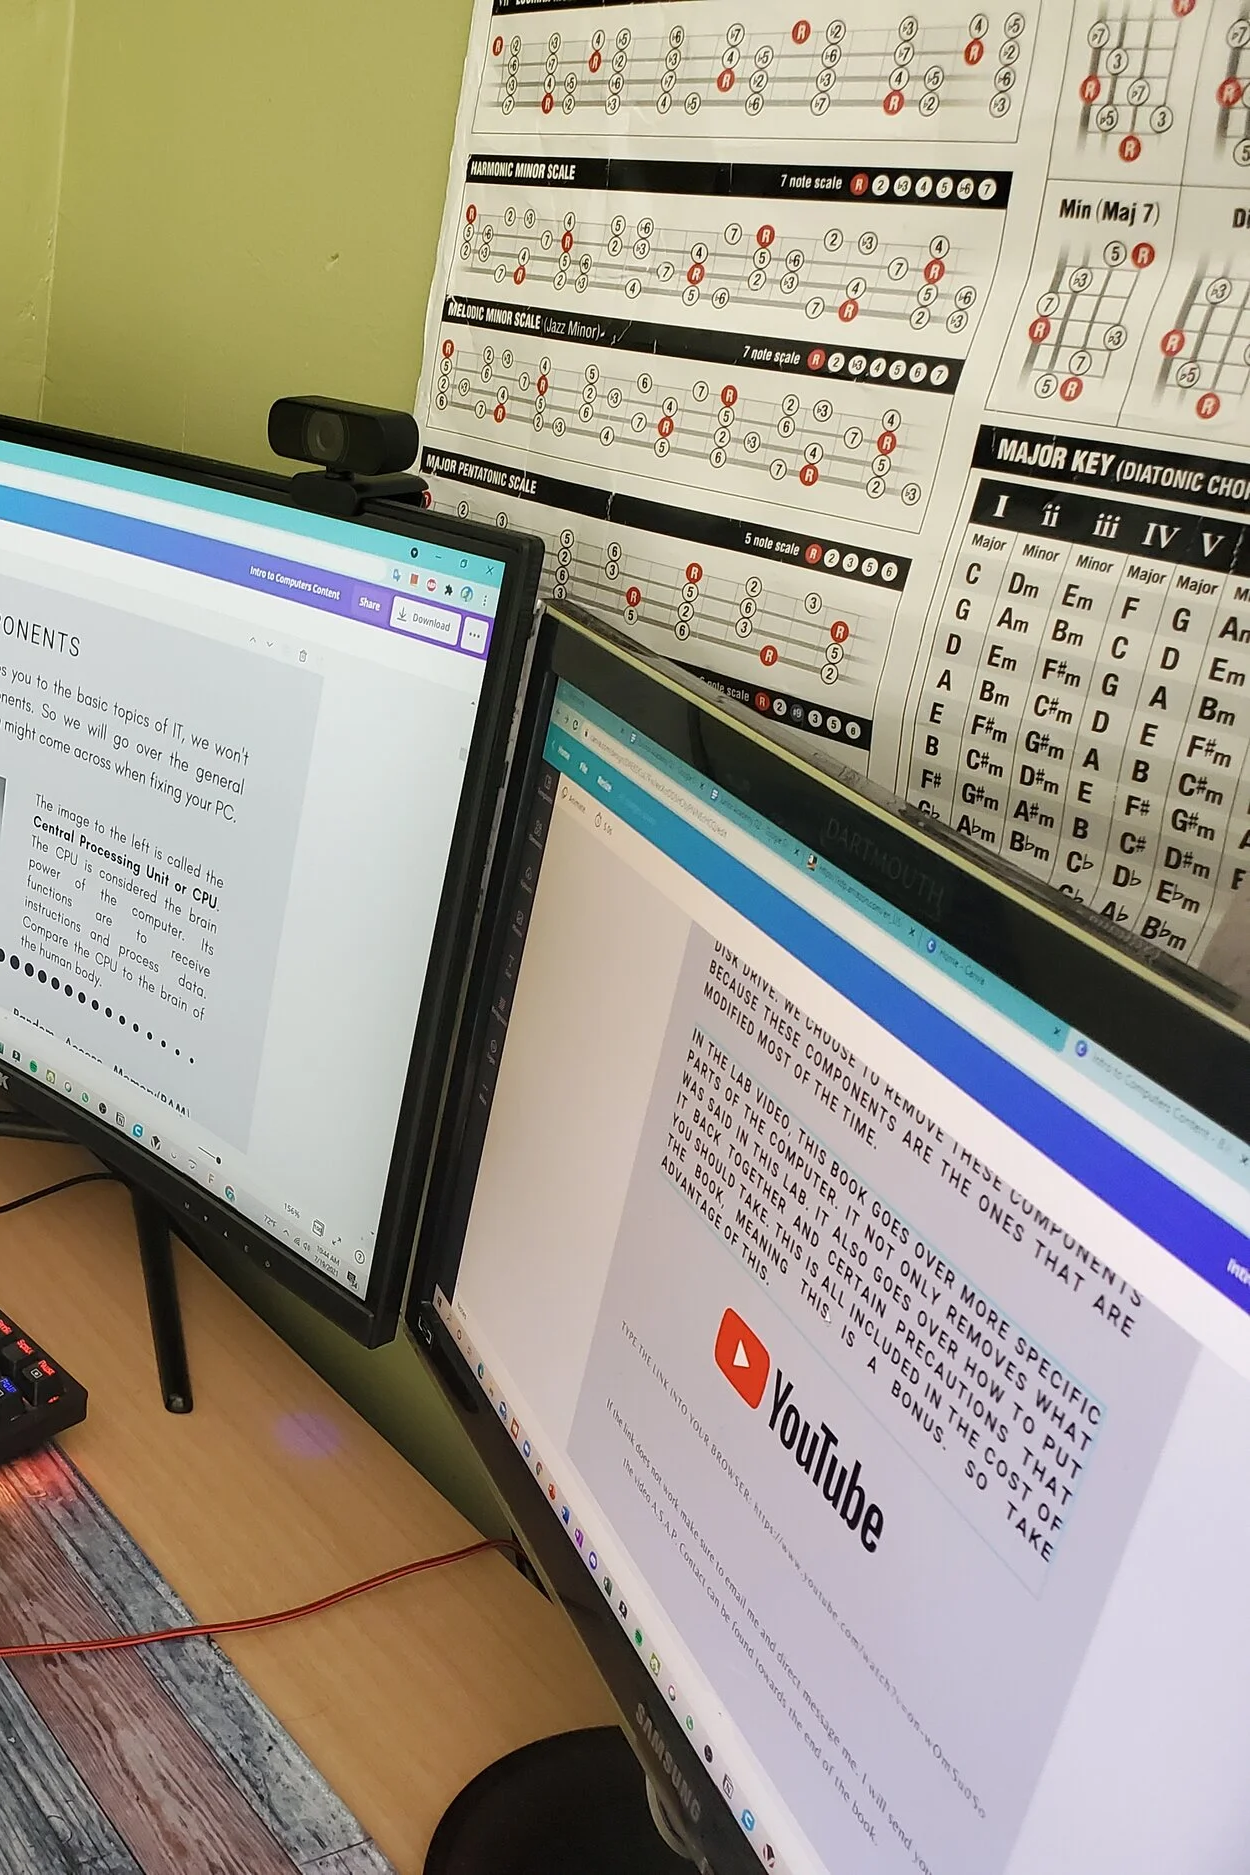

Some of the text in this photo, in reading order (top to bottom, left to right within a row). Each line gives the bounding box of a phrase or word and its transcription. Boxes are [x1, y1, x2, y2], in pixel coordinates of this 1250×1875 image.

[470, 160, 576, 181] HARMONIC MINOR SCALE
[780, 174, 843, 190] 7 note scale
[1059, 198, 1160, 227] Min (Maj 7)
[448, 302, 601, 341] MELODIC MINOR SCALE (Jazz Minor)
[426, 453, 538, 495] MAJOR PENTATONIC SCALE
[996, 437, 1068, 471] MAJOR
[1070, 449, 1117, 478] KEY
[1115, 459, 1206, 493] (DIATONIC
[744, 532, 800, 557] 5 note scale
[971, 532, 1220, 597] Major Minor Minor Major Major
[1041, 503, 1061, 528] ii
[1093, 512, 1122, 539] iii
[1141, 521, 1182, 550] IV
[1200, 531, 1226, 558] V
[249, 564, 341, 601] Intro to Computers Content
[358, 596, 381, 612] Share
[965, 561, 1192, 633] C Dm Em F G
[412, 611, 451, 632] Download
[955, 597, 1181, 671] G Am Bm C D
[11, 668, 32, 685] you
[36, 674, 48, 690] to
[53, 678, 72, 699] the
[76, 685, 108, 712] basic
[113, 701, 150, 728] topics
[154, 717, 169, 734] of
[172, 721, 185, 744] IT,
[190, 733, 209, 750] we
[214, 742, 249, 766] won't
[41, 702, 57, 721] So
[63, 714, 81, 730] we
[87, 722, 107, 741] will
[112, 734, 129, 750] go
[136, 743, 163, 761] over
[169, 750, 189, 772] the
[195, 767, 245, 796] general
[929, 701, 1151, 785] E F#m G#m A B
[33, 815, 220, 912] Central Processing Unit or CPU.
[35, 793, 224, 889] The image to the left is called the
[703, 981, 877, 1150] MODIFIED MOST OF THE TIME.
[660, 1154, 769, 1286] ADVANTAGE OF THIS.
[691, 1027, 1101, 1425] IN THE LAB VIDEO, THIS BOOK GOES OVER MORE SPECIFIC
[621, 1320, 638, 1348] TYPE
[638, 1344, 652, 1367] THE
[652, 1364, 669, 1391] LINK
[669, 1388, 688, 1416] INTO
[688, 1413, 710, 1447] YOUR
[768, 1367, 884, 1553] YouTube
[634, 1700, 702, 1825] SAMSUNG
